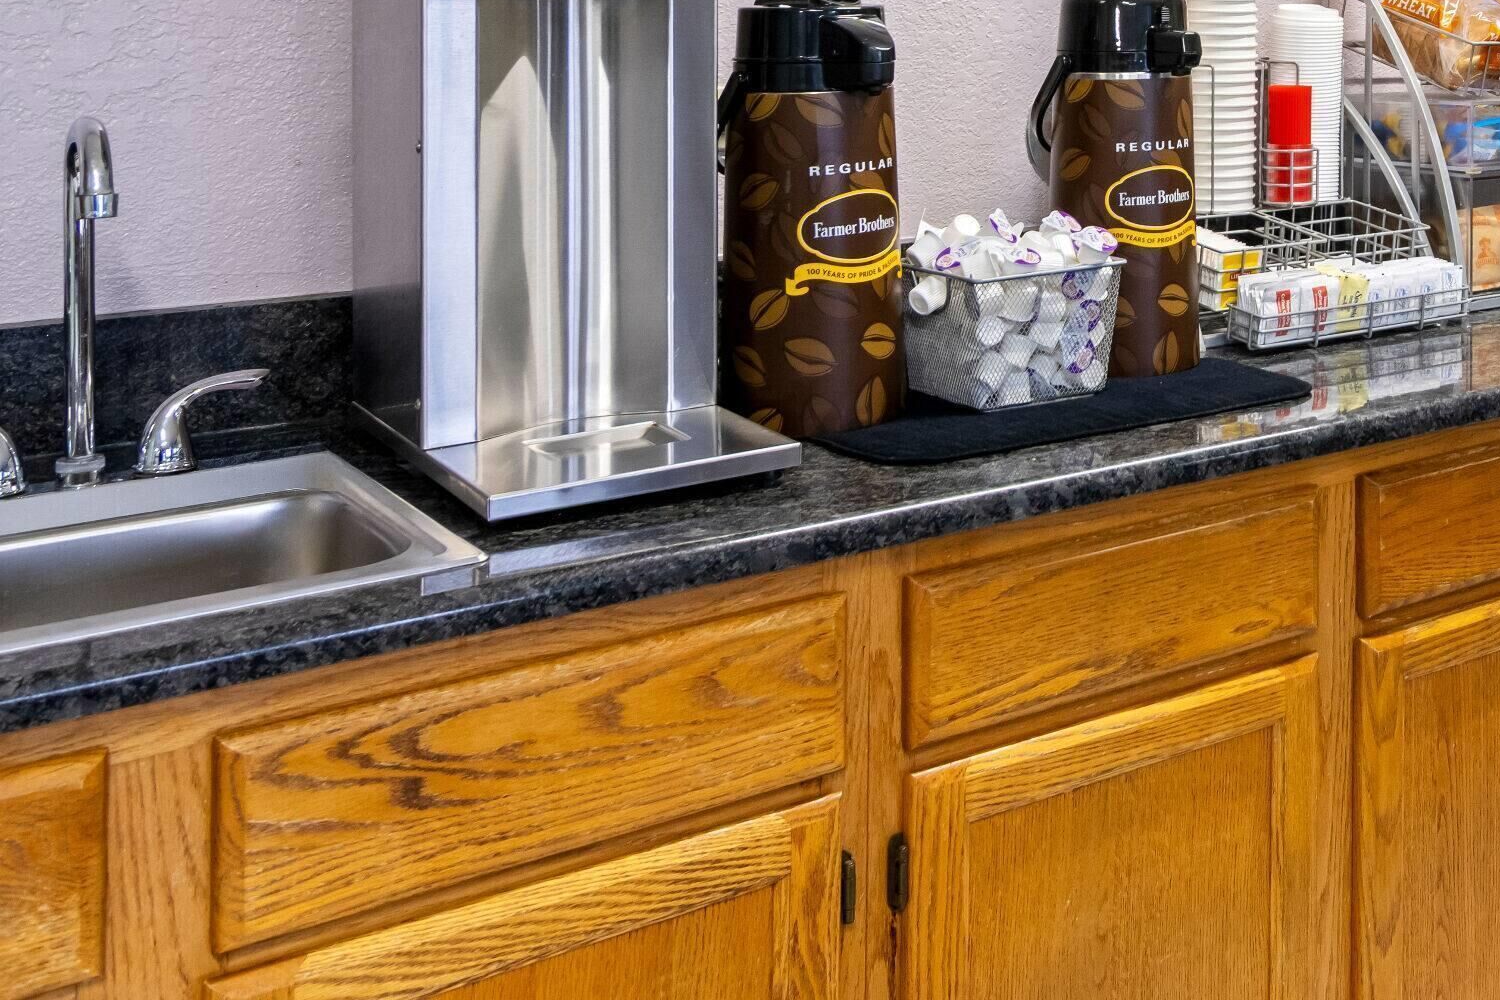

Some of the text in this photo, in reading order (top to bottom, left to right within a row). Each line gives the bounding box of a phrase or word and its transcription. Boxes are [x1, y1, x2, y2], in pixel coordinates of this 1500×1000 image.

[1115, 138, 1190, 153] REGULAR
[808, 157, 894, 177] REGULAR
[1118, 188, 1191, 207] Farmer Brothers
[813, 214, 896, 239] Farmer Brothers
[1125, 233, 1145, 243] YEARS
[1157, 236, 1173, 244] PRIDE
[806, 268, 820, 276] 100
[822, 268, 846, 279] YEARS
[858, 268, 877, 278] PRIDE
